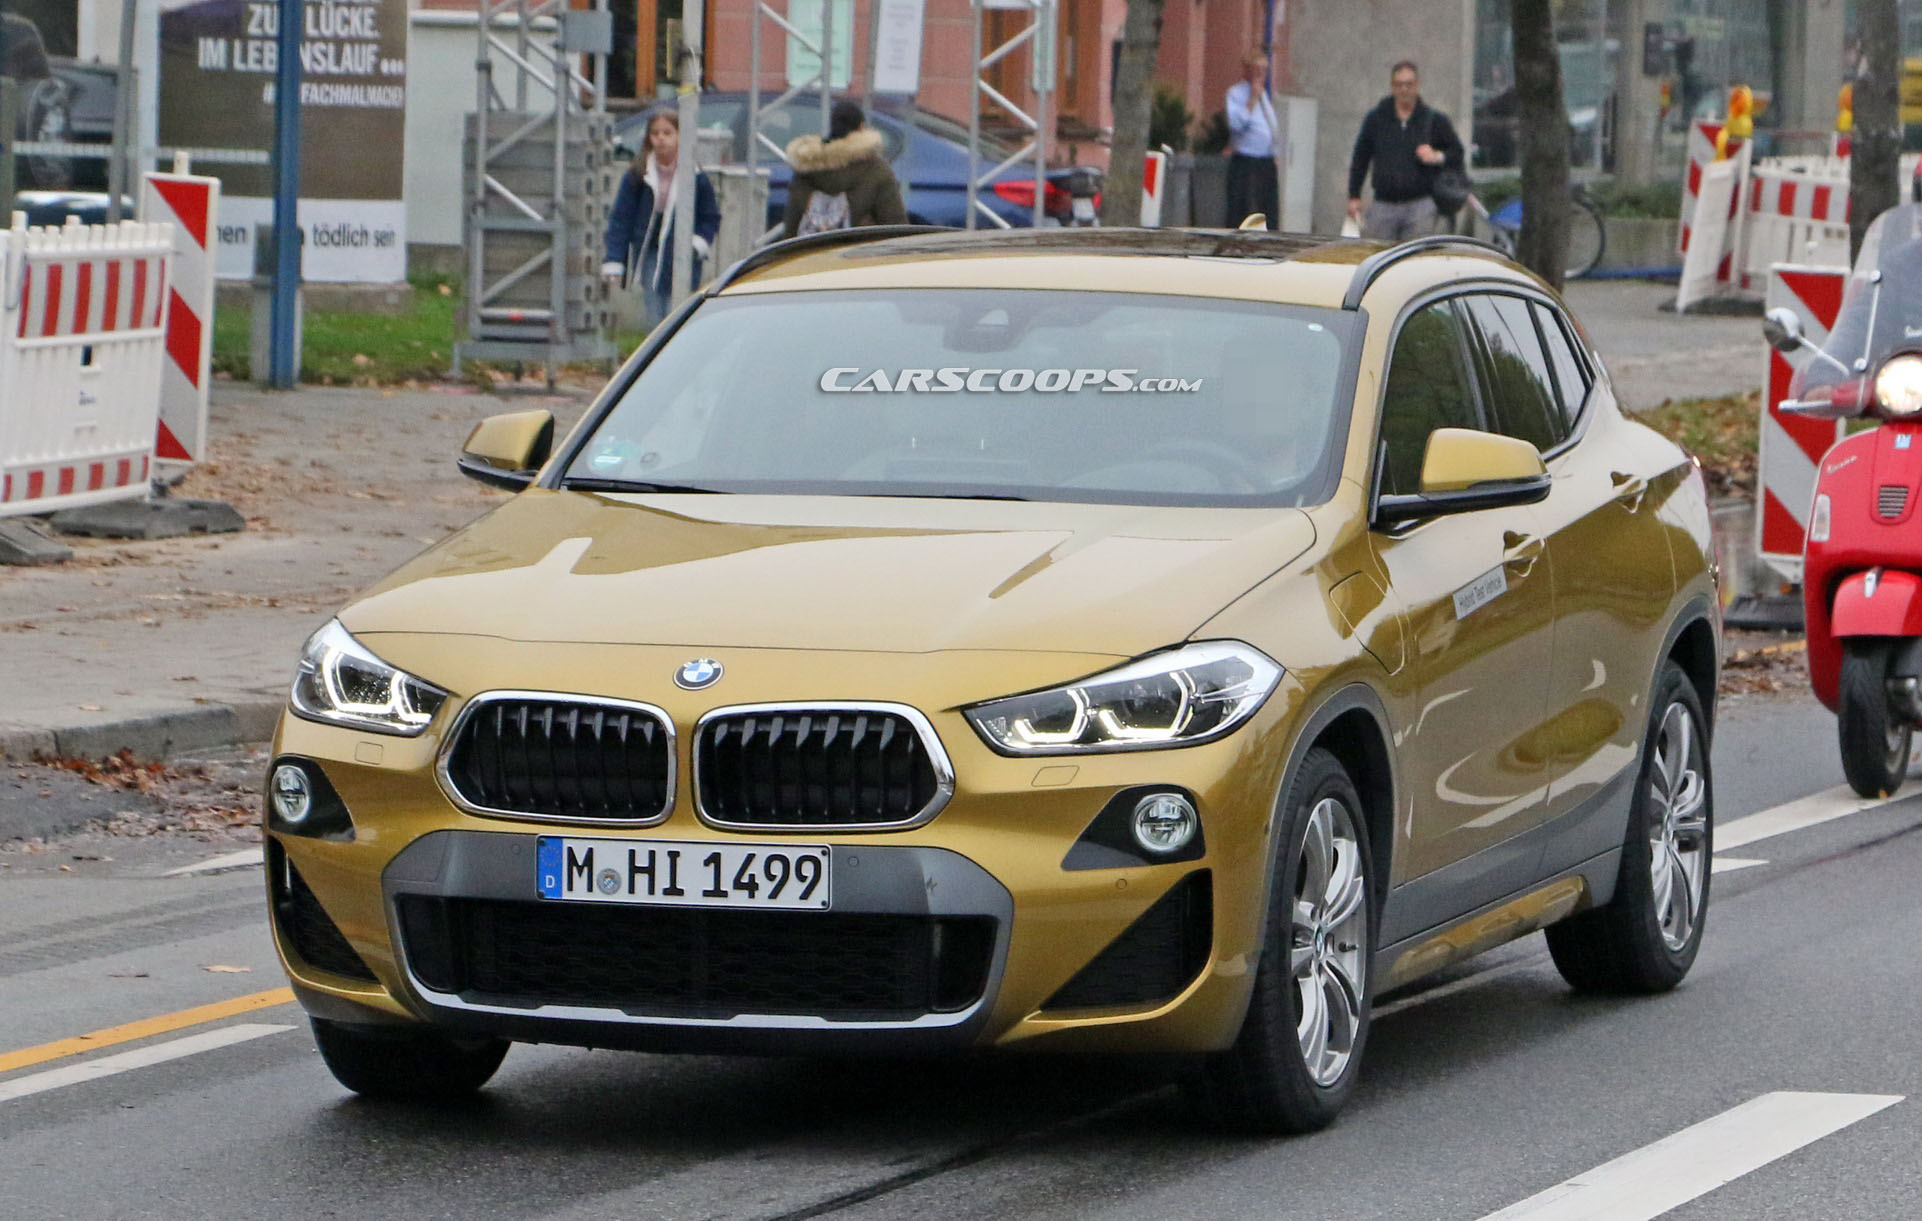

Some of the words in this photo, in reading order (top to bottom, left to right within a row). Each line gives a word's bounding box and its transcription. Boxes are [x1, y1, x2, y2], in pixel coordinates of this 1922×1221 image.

[247, 4, 279, 37] ZU
[198, 38, 227, 70] IM
[313, 224, 368, 248] tödlich
[545, 875, 555, 889] D
[566, 846, 594, 893] M
[628, 848, 685, 896] HI
[702, 851, 823, 901] 1499
